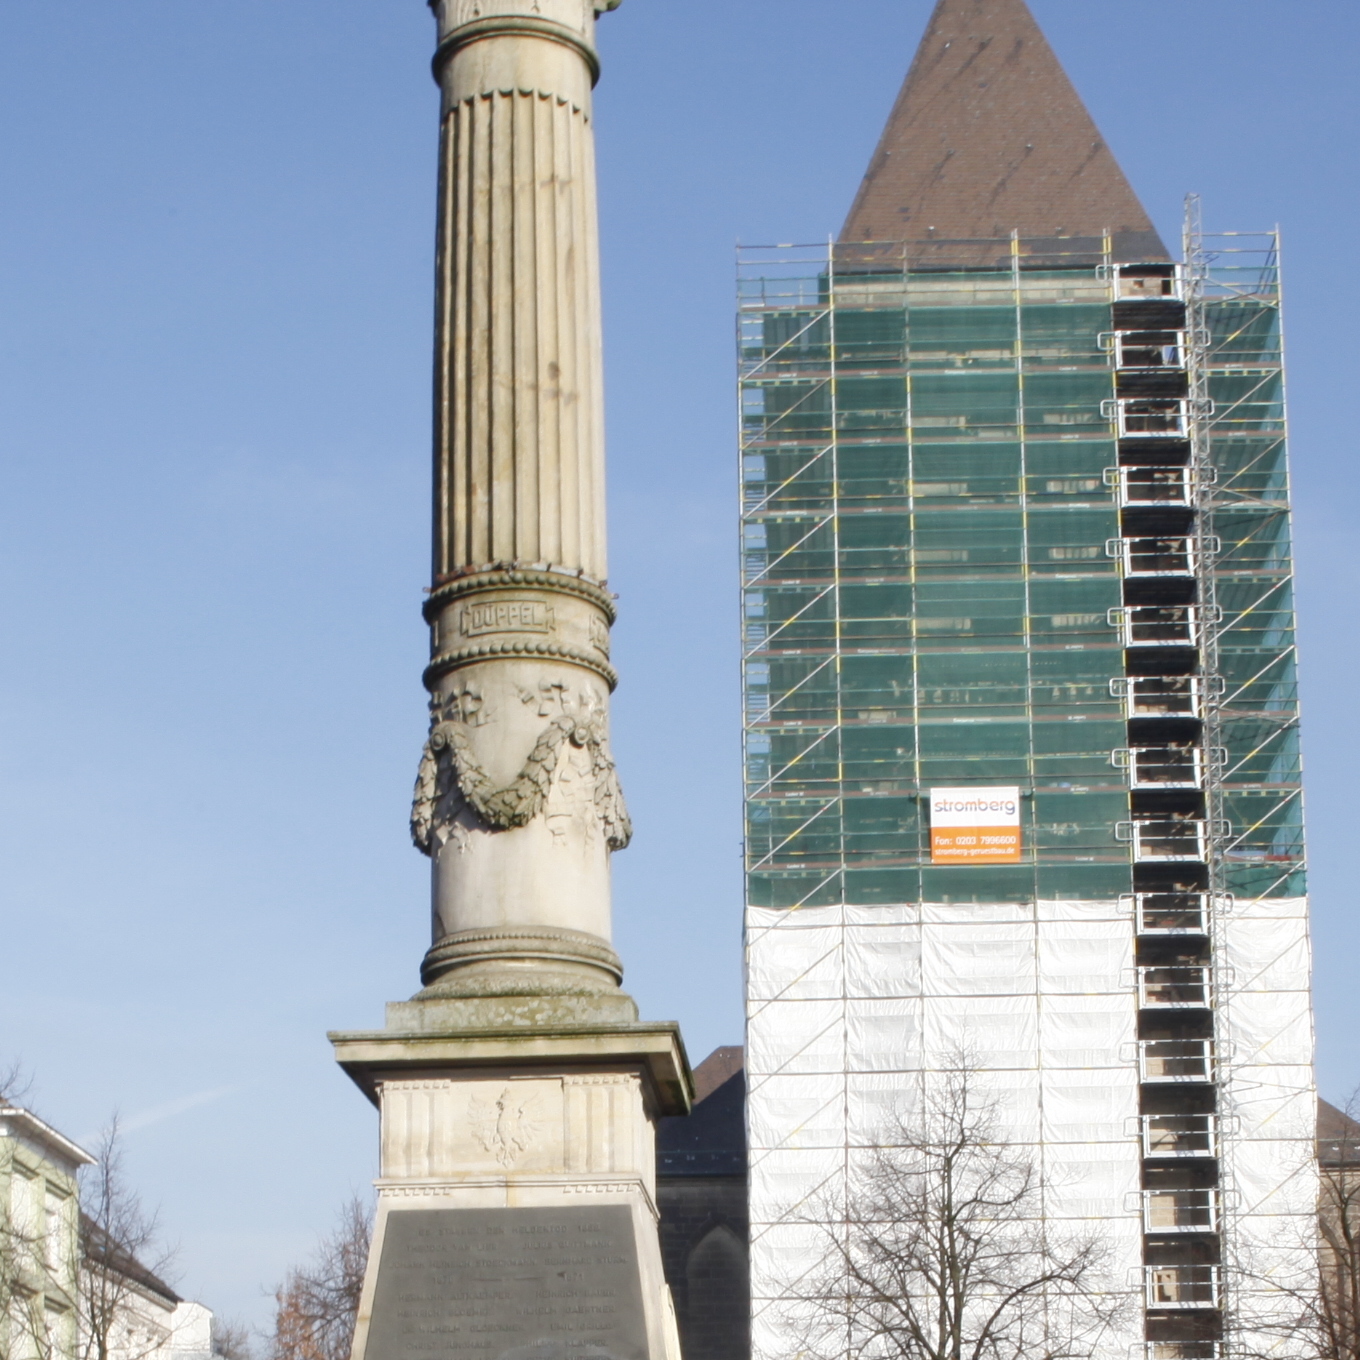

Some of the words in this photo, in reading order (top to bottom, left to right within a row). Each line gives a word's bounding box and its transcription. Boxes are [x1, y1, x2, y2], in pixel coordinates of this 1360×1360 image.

[934, 798, 1016, 815] stromberg
[935, 836, 952, 845] Fon:
[955, 836, 977, 845] 0203
[980, 835, 1016, 844] 7996600
[935, 847, 1015, 856] stromberg-geruestbau.de
